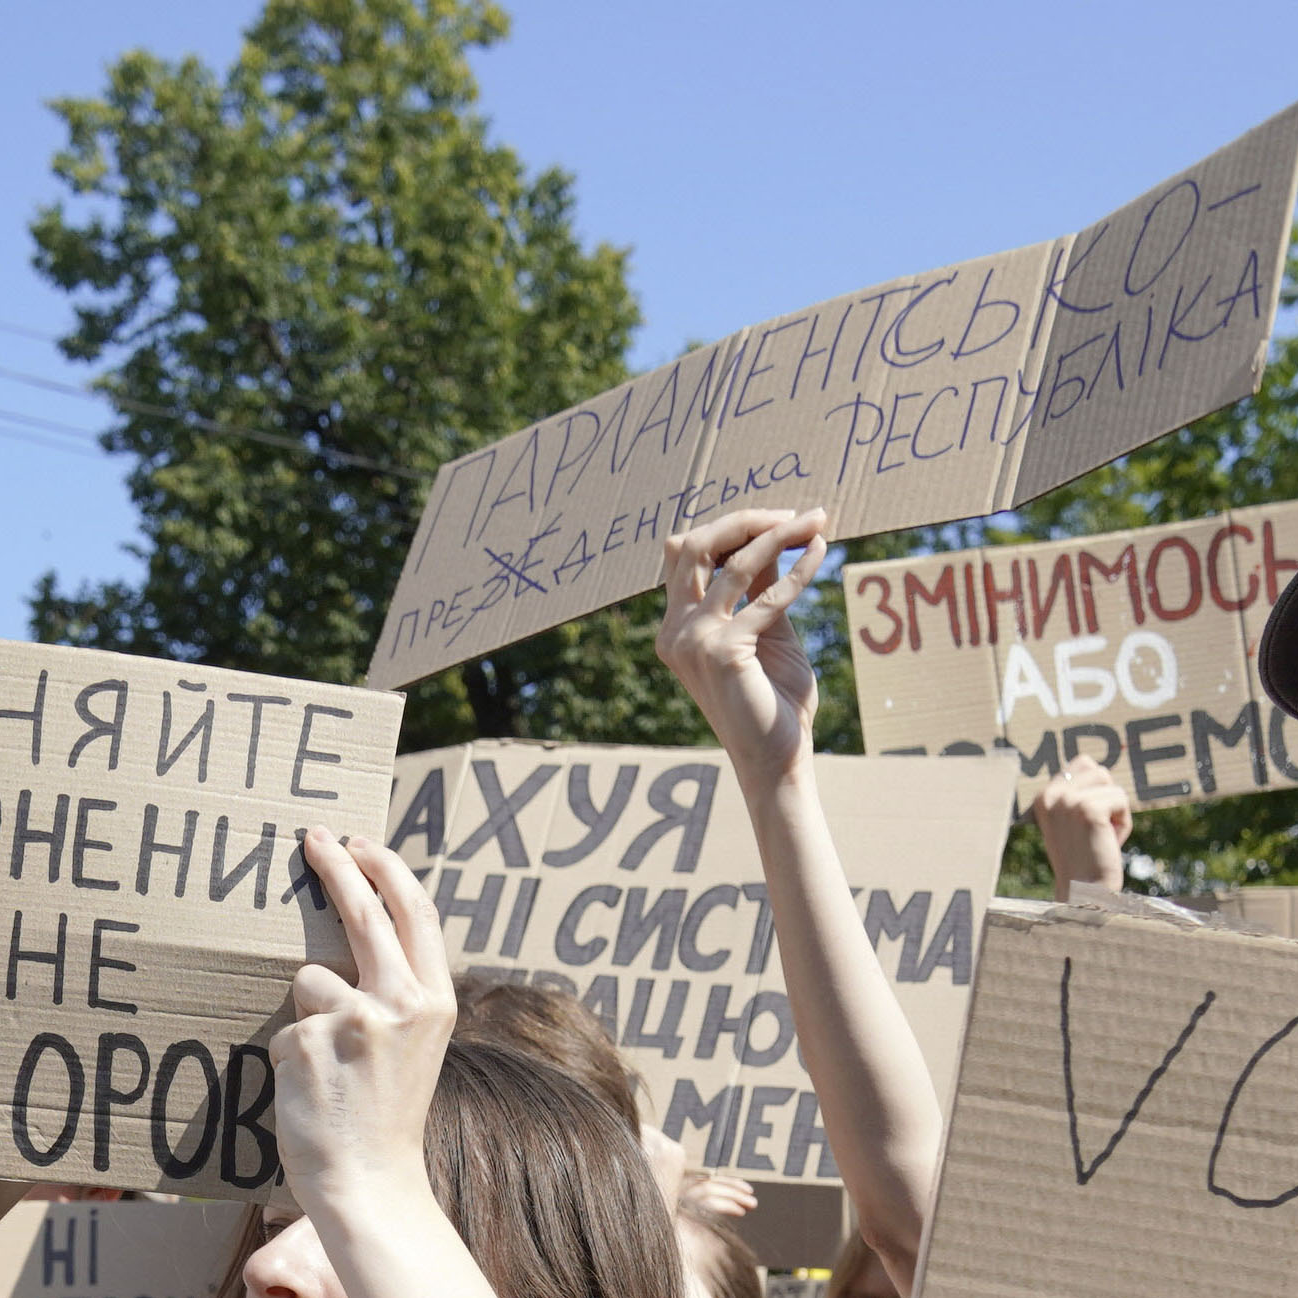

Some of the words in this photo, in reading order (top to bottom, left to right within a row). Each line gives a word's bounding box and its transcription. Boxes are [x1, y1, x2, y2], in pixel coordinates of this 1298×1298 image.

[825, 249, 1264, 485] РЕСПУБЛІКА
[995, 630, 1180, 726] АБО
[388, 759, 721, 872] АХУЯ
[5, 910, 141, 1014] НЕ
[414, 866, 542, 959] НІ
[555, 882, 973, 985] СИСТМА
[42, 1208, 99, 1288] НІ
